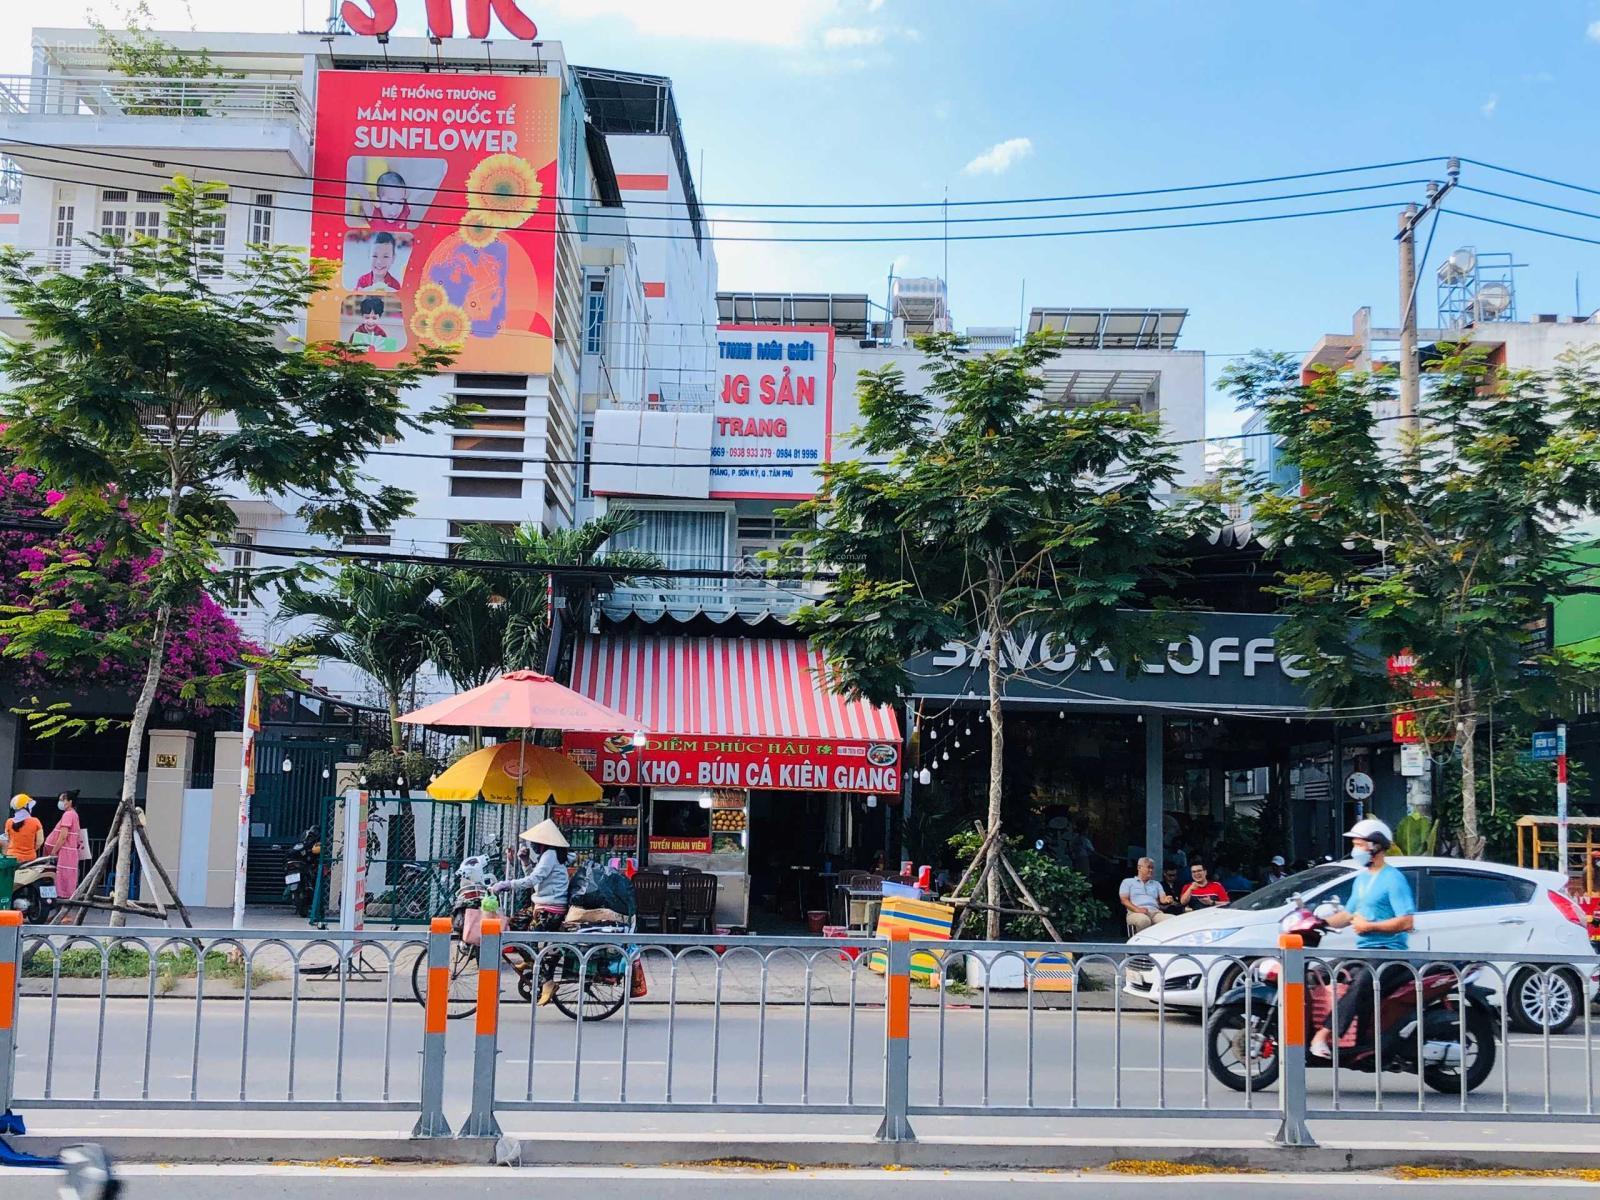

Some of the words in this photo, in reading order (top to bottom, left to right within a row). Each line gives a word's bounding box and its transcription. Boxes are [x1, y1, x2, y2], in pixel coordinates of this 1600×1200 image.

[382, 85, 397, 100] HỆ
[400, 84, 443, 99] THỐNG
[401, 107, 438, 122] NON
[442, 103, 492, 125] QUỐC
[496, 103, 516, 125] TẾ
[354, 126, 518, 152] SUNFLOWER
[757, 340, 783, 361] MÔI
[759, 365, 815, 406] SẢN
[717, 416, 788, 438] TRANG
[729, 447, 745, 458] 0938
[746, 448, 758, 458] 933
[760, 448, 772, 458] 379
[703, 739, 763, 754] PHÚC
[768, 741, 810, 756] HẬU
[602, 753, 631, 783] BÒ
[636, 760, 680, 784] KHO
[698, 755, 740, 785] BÚN
[745, 757, 773, 787] CÁ
[779, 759, 829, 788] KIÊN
[834, 766, 897, 791] GIANG
[1349, 778, 1356, 793] 5
